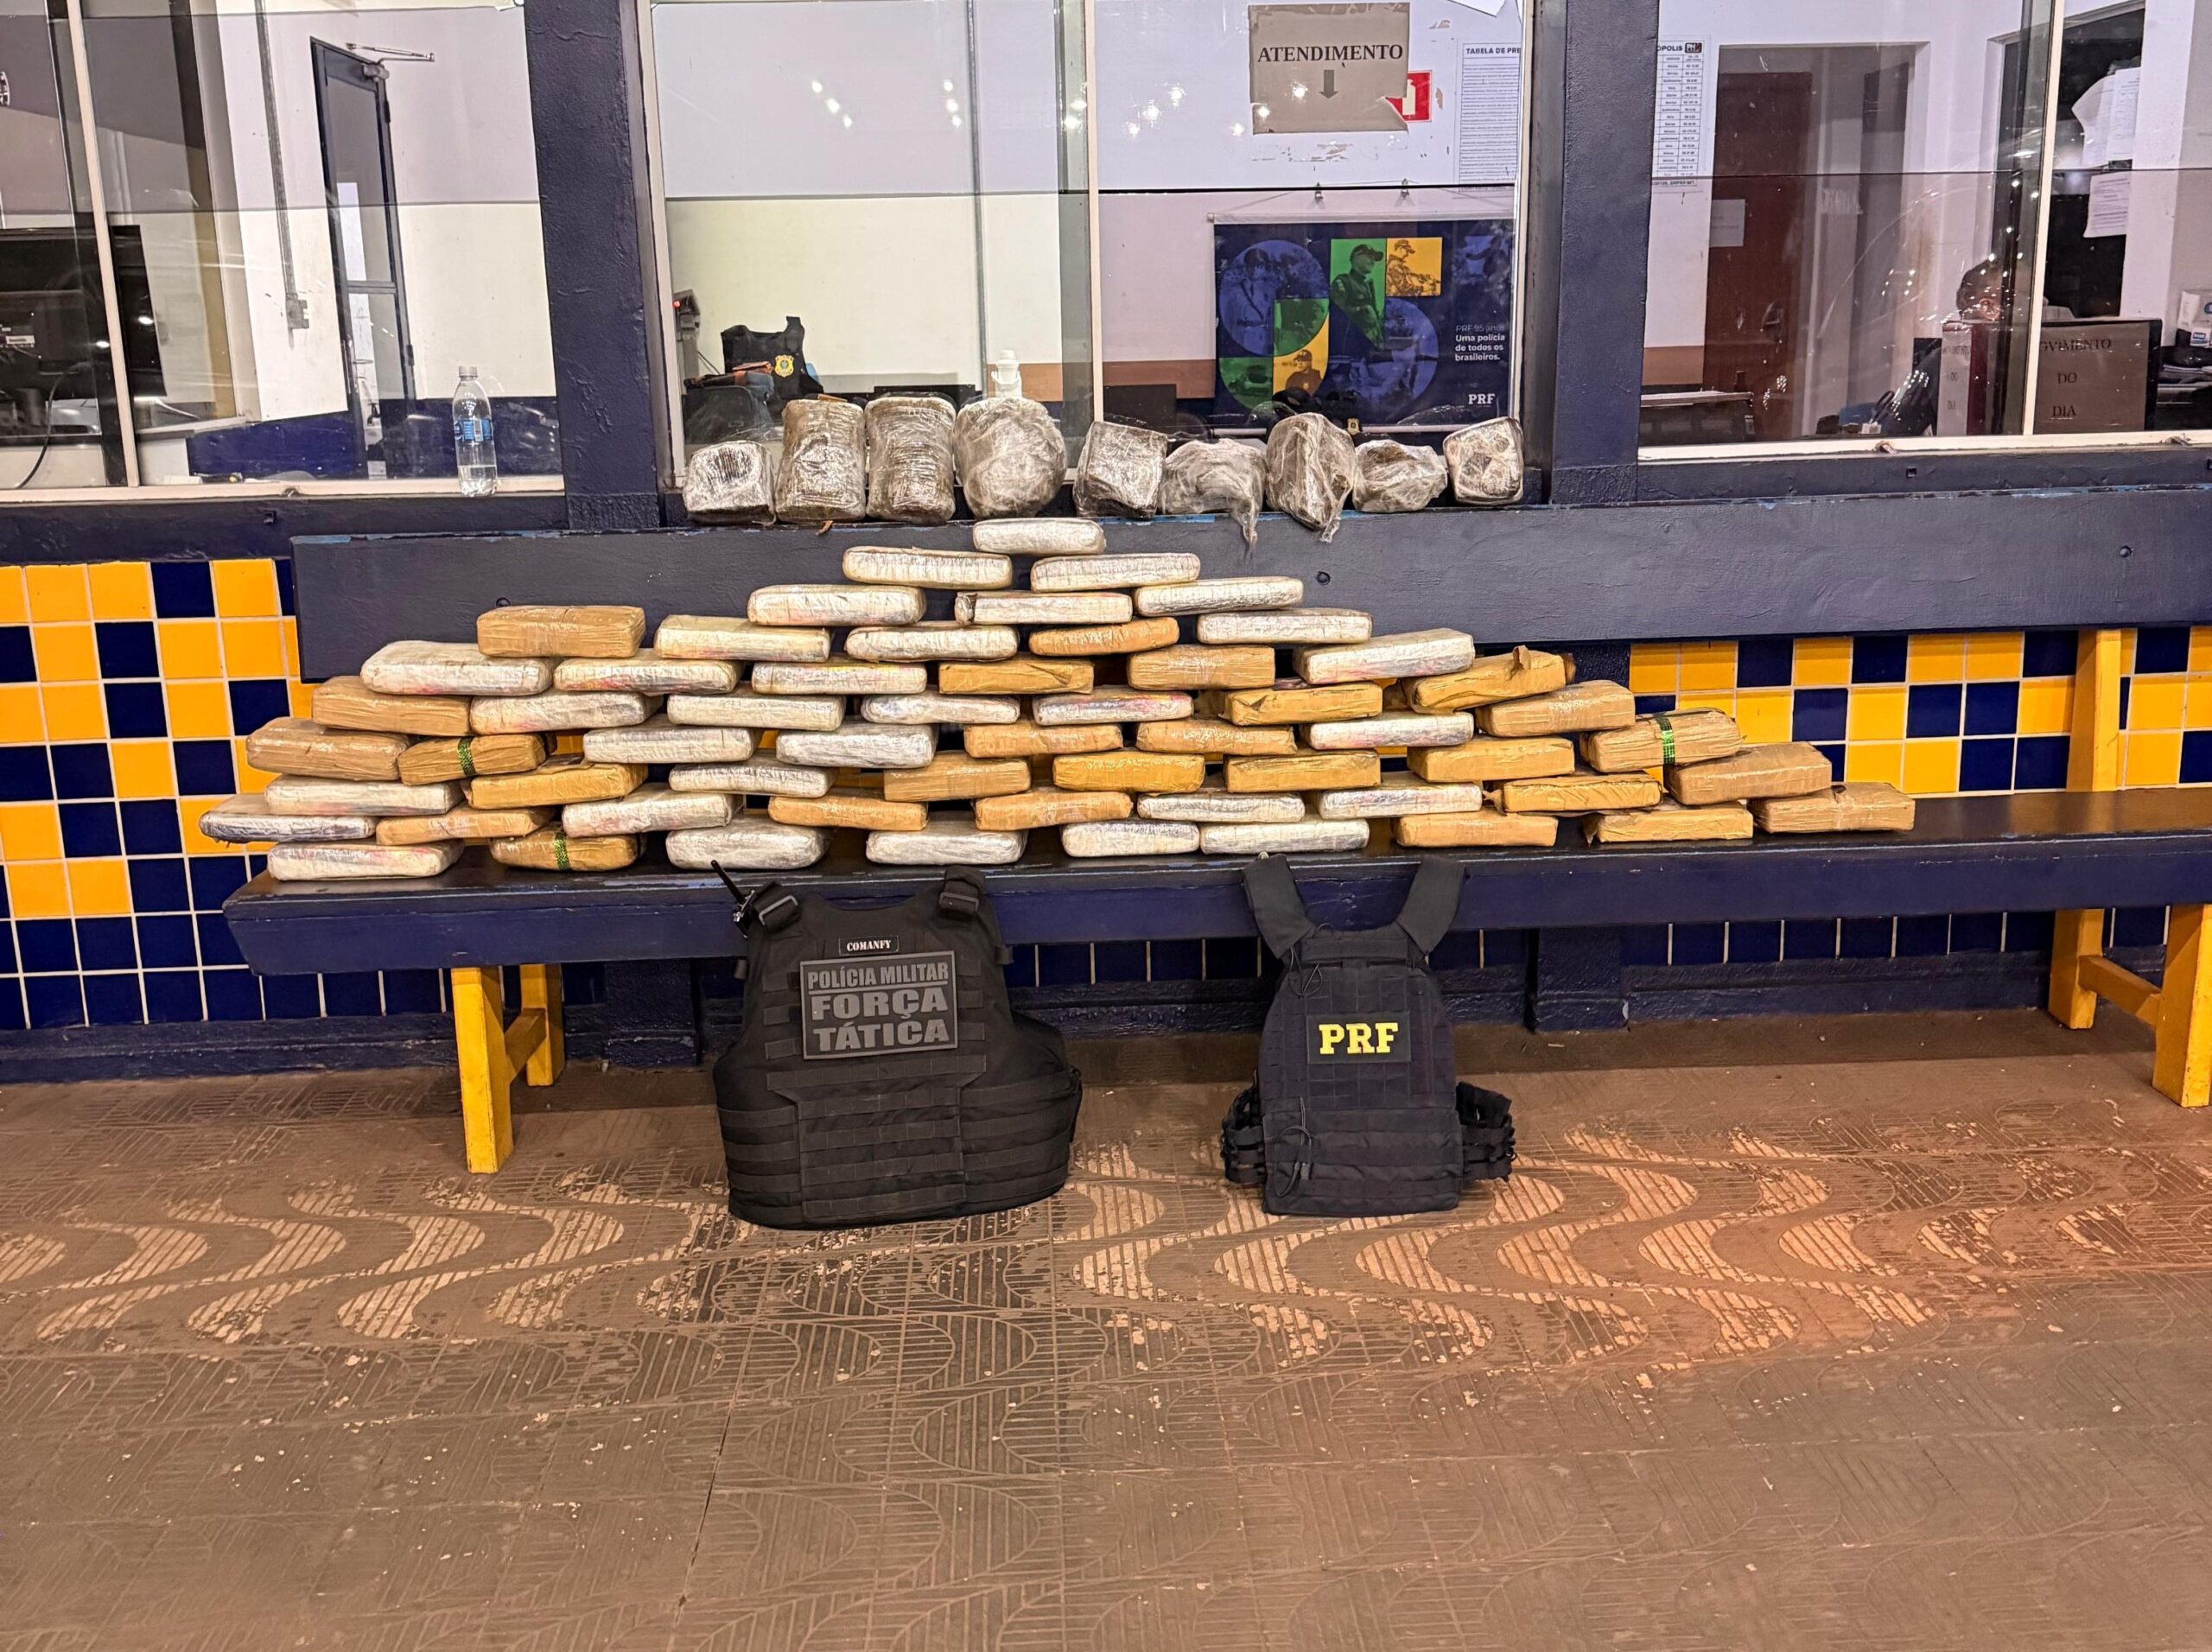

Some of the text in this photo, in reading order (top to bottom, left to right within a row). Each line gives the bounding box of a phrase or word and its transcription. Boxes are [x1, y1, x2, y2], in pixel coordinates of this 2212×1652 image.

[1258, 44, 1403, 62] ATENDIMENTO
[1455, 353, 1501, 361] brasileiros.
[2057, 372, 2077, 384] DO
[1468, 393, 1496, 404] PRF
[2052, 405, 2076, 416] DIA
[808, 962, 949, 990] POLÍCIA MILITAR
[811, 987, 949, 1020] FORÇA
[813, 1019, 950, 1052] TÁTICA
[1319, 1022, 1398, 1054] PRF
